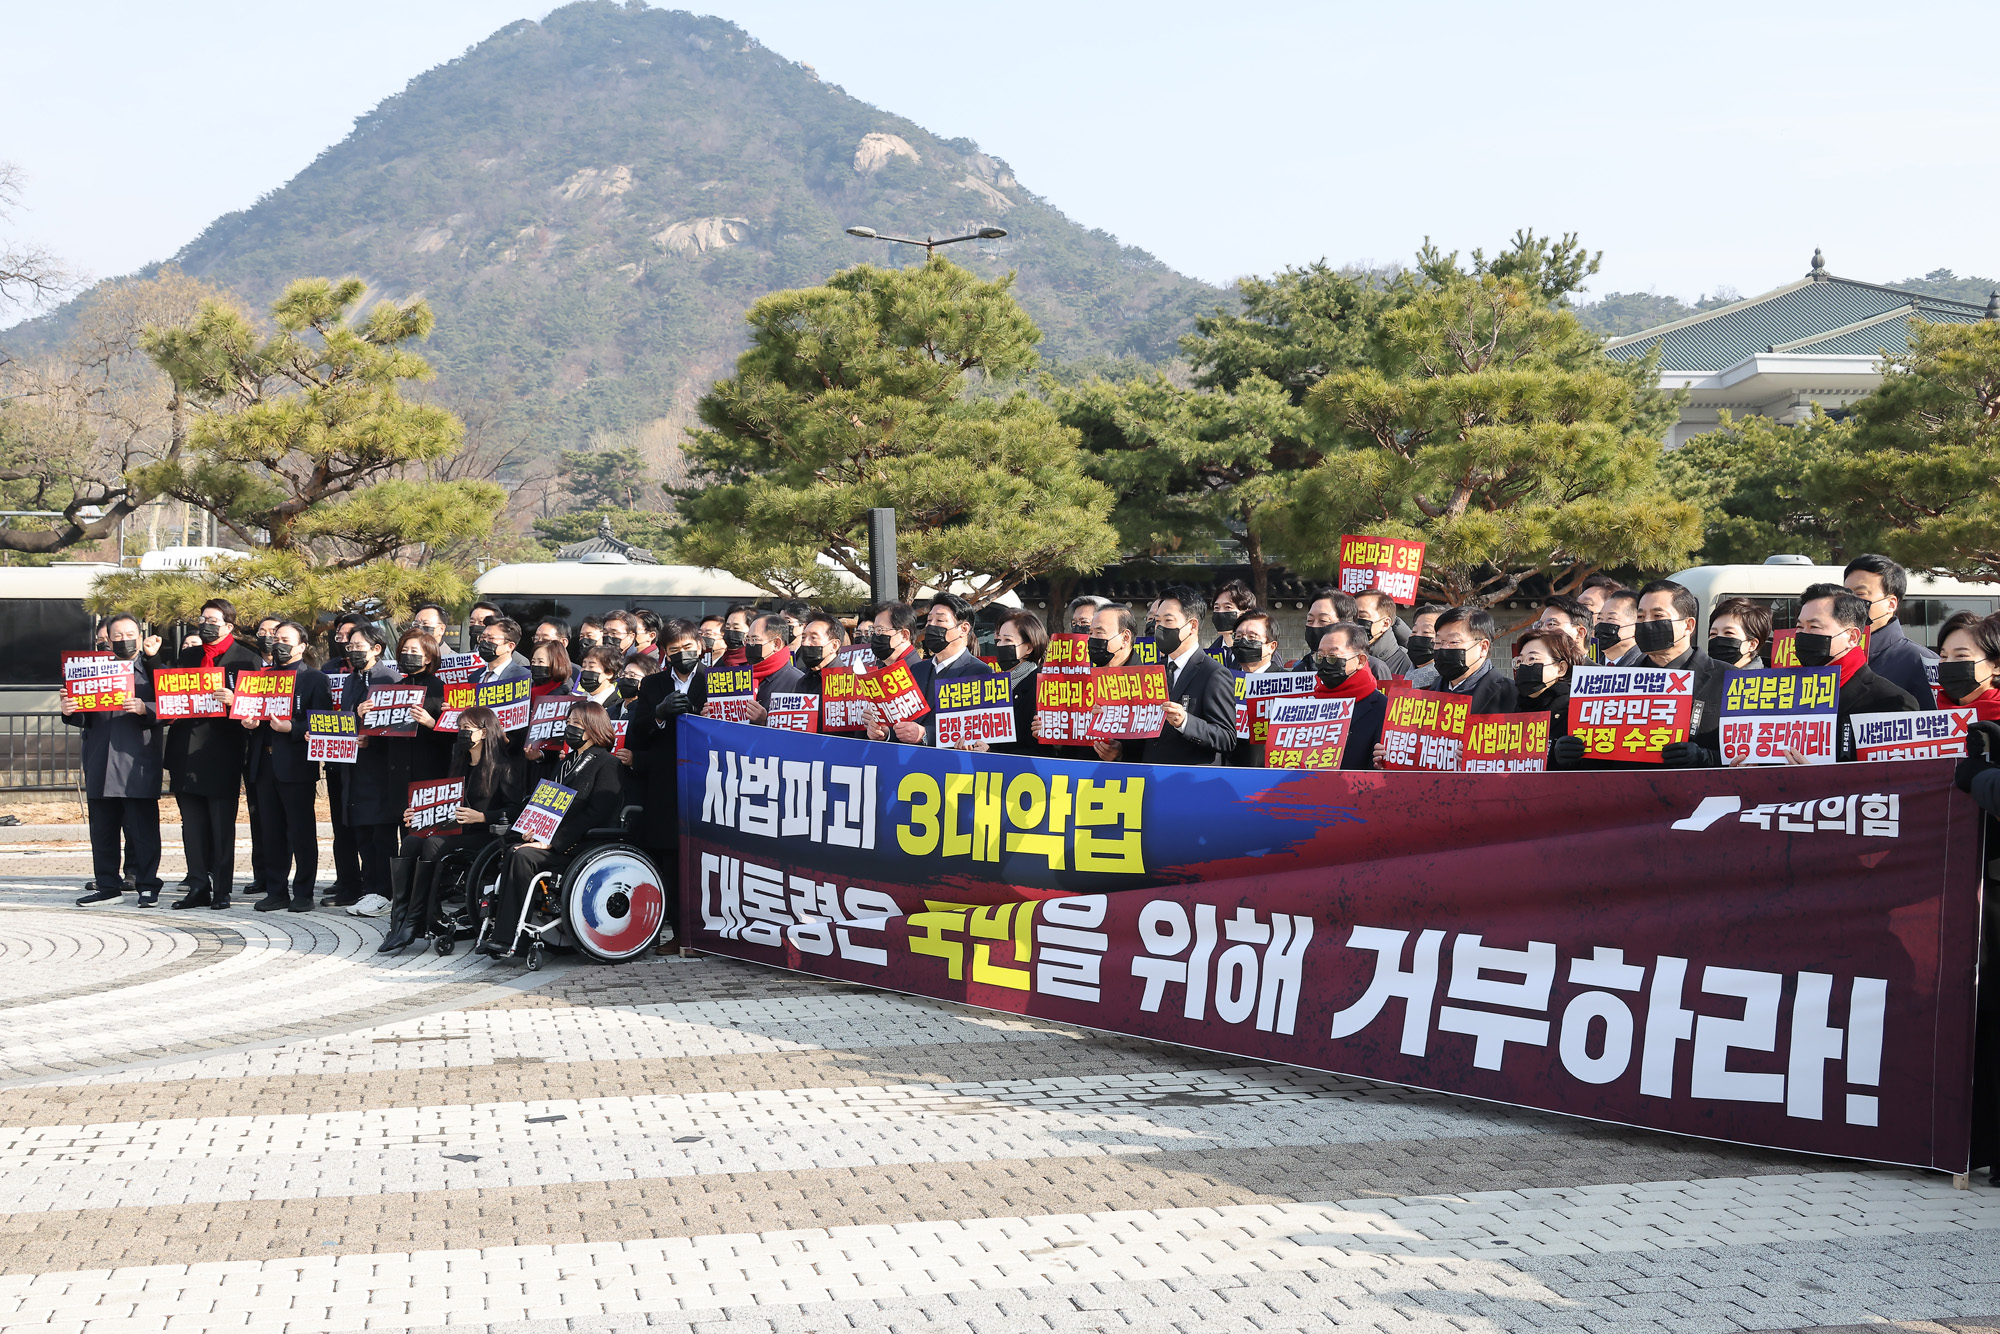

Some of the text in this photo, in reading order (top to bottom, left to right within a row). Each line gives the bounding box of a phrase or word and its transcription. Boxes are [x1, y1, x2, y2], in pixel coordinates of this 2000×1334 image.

[1343, 541, 1421, 572] 사법파괴 3법
[1341, 567, 1416, 599] 대통령은 거부하라!
[67, 663, 119, 679] 사법파괴 악법
[455, 654, 471, 667] 악법
[72, 676, 127, 695] 대한민국
[158, 672, 200, 692] 사법파괴
[203, 671, 223, 691] 3법
[238, 675, 277, 694] 사법파괴
[278, 675, 294, 694] 3법
[478, 677, 531, 707] 삼권분립 파괴
[707, 669, 752, 694] 삼권분립 파괴
[824, 673, 855, 697] 사법파괴
[882, 666, 913, 694] 3법
[1097, 672, 1166, 701] 사법파괴 3법
[1249, 674, 1314, 695] 사법파괴 악법
[1574, 672, 1666, 694] 사법파괴 악법
[1727, 673, 1837, 711] 삼권분립 파괴
[158, 694, 190, 715] 대통령은
[371, 689, 424, 707] 사법 파괴
[448, 688, 476, 709] 사법파
[782, 696, 802, 710] 악법
[938, 677, 1010, 709] 삼권분립 파괴
[1038, 680, 1083, 707] 사법파괴
[233, 696, 263, 717] 대통령은
[264, 696, 291, 717] 거부하라!
[364, 708, 392, 729] 독재
[533, 701, 559, 720] 사법
[825, 701, 846, 727] 대통령은
[877, 689, 925, 723] 거부하라!
[1273, 703, 1320, 722] 사법파괴
[1320, 701, 1341, 720] 악법
[1387, 695, 1468, 735] 사법파괴 3법
[1579, 699, 1677, 725] 대한민국
[309, 713, 356, 734] 삼권분립 파괴
[529, 721, 553, 742] 독재
[767, 713, 809, 731] 한민국
[938, 712, 1012, 743] 당장 중단하라!
[1037, 710, 1069, 740] 대통령은
[1092, 704, 1130, 734] 대통령은
[1130, 704, 1165, 734] 거부하라!
[1858, 713, 1949, 745] 사법파괴 악법
[1275, 723, 1343, 748] 대한민국
[1383, 729, 1418, 766] 대통령은
[1467, 720, 1548, 754] 사법파괴 3법
[1723, 720, 1831, 759] 당장 중단하라!
[310, 738, 356, 759] 당장 중단하라!
[1304, 747, 1342, 770] 수호!
[411, 781, 463, 808] 사법 파괴
[411, 806, 435, 831] 독재
[701, 749, 1146, 875] 사법파괴 3대악법
[1739, 793, 1899, 838] 국민의힘
[700, 851, 1888, 1128] 대통령은 국민을 위해 거부하라!
